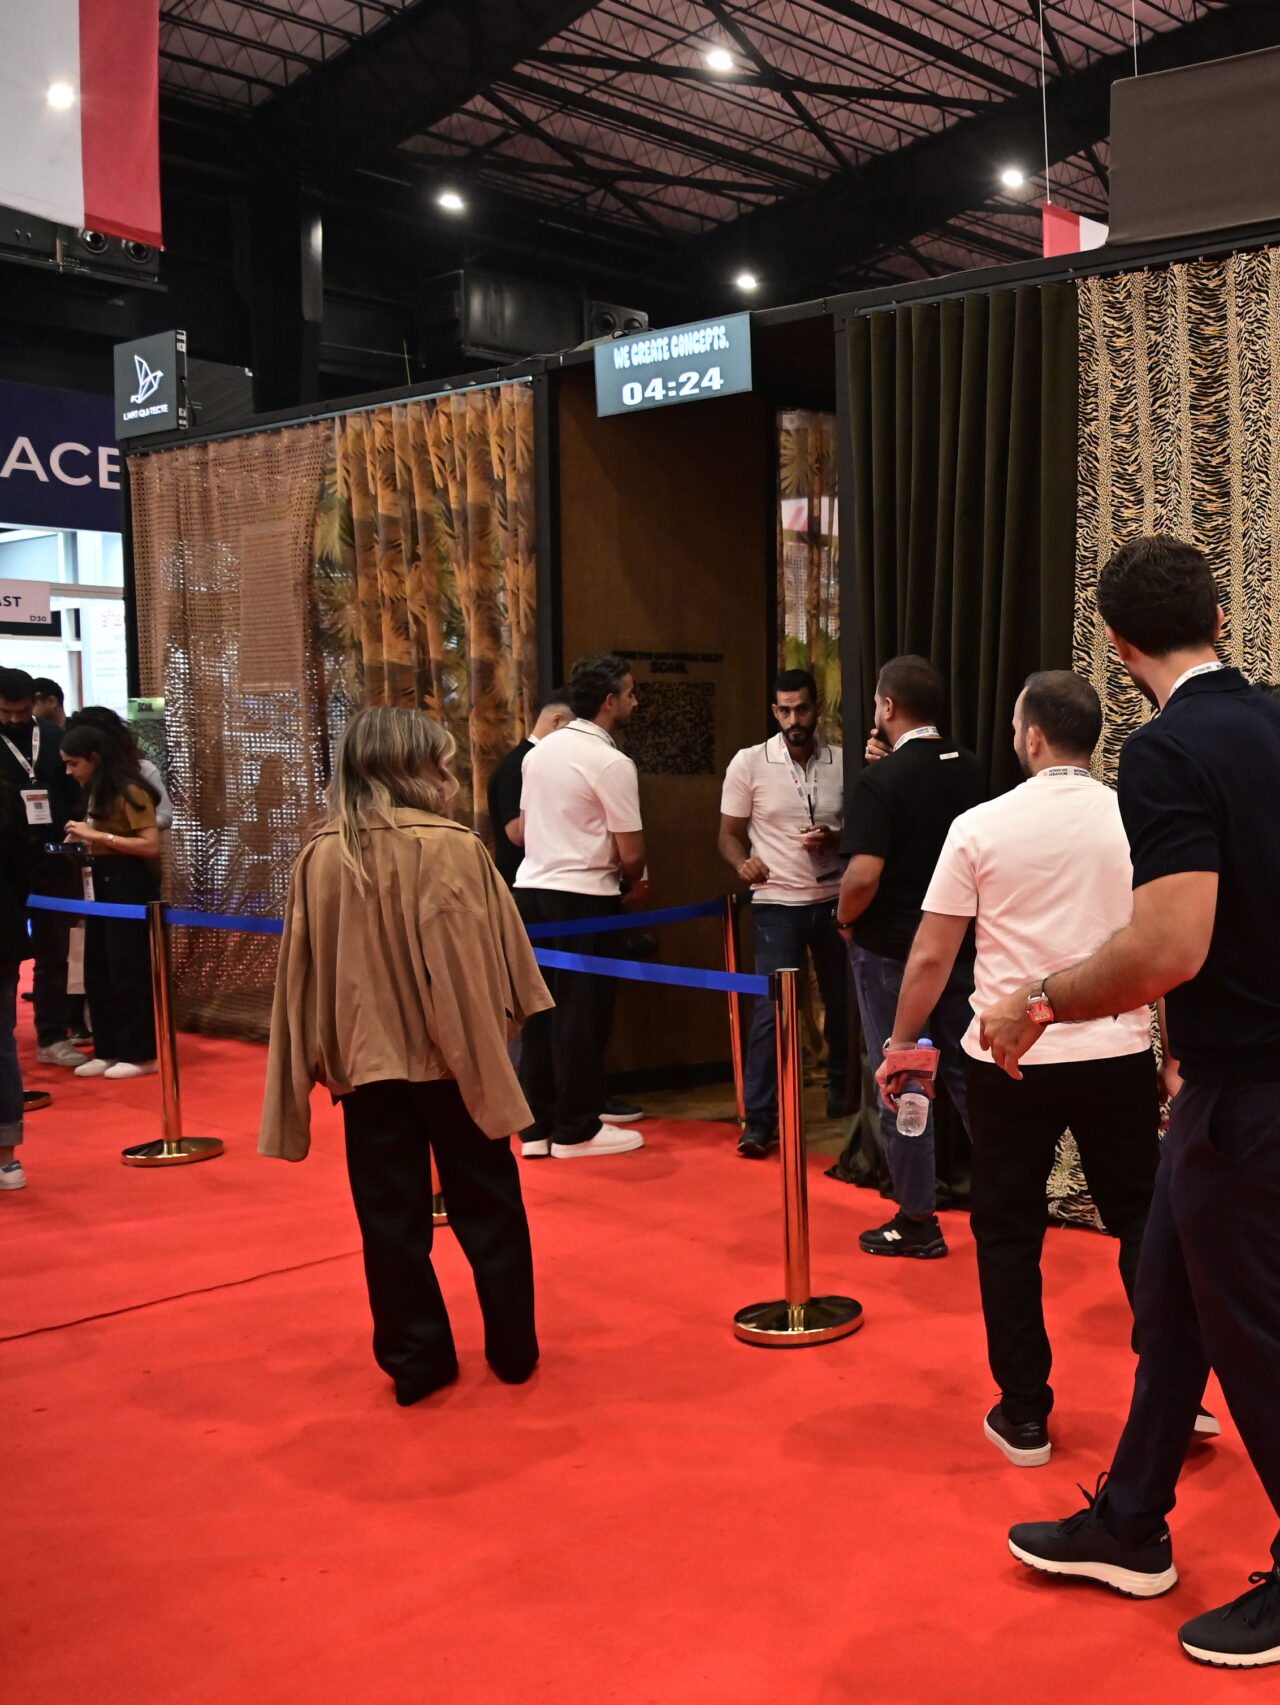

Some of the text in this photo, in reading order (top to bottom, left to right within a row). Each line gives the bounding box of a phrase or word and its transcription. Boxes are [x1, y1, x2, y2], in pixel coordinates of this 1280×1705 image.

[613, 325, 730, 369] WE CREATE CONCEPTS.
[621, 366, 724, 406] 04:24
[0, 436, 120, 490] ACE
[0, 596, 21, 607] ST
